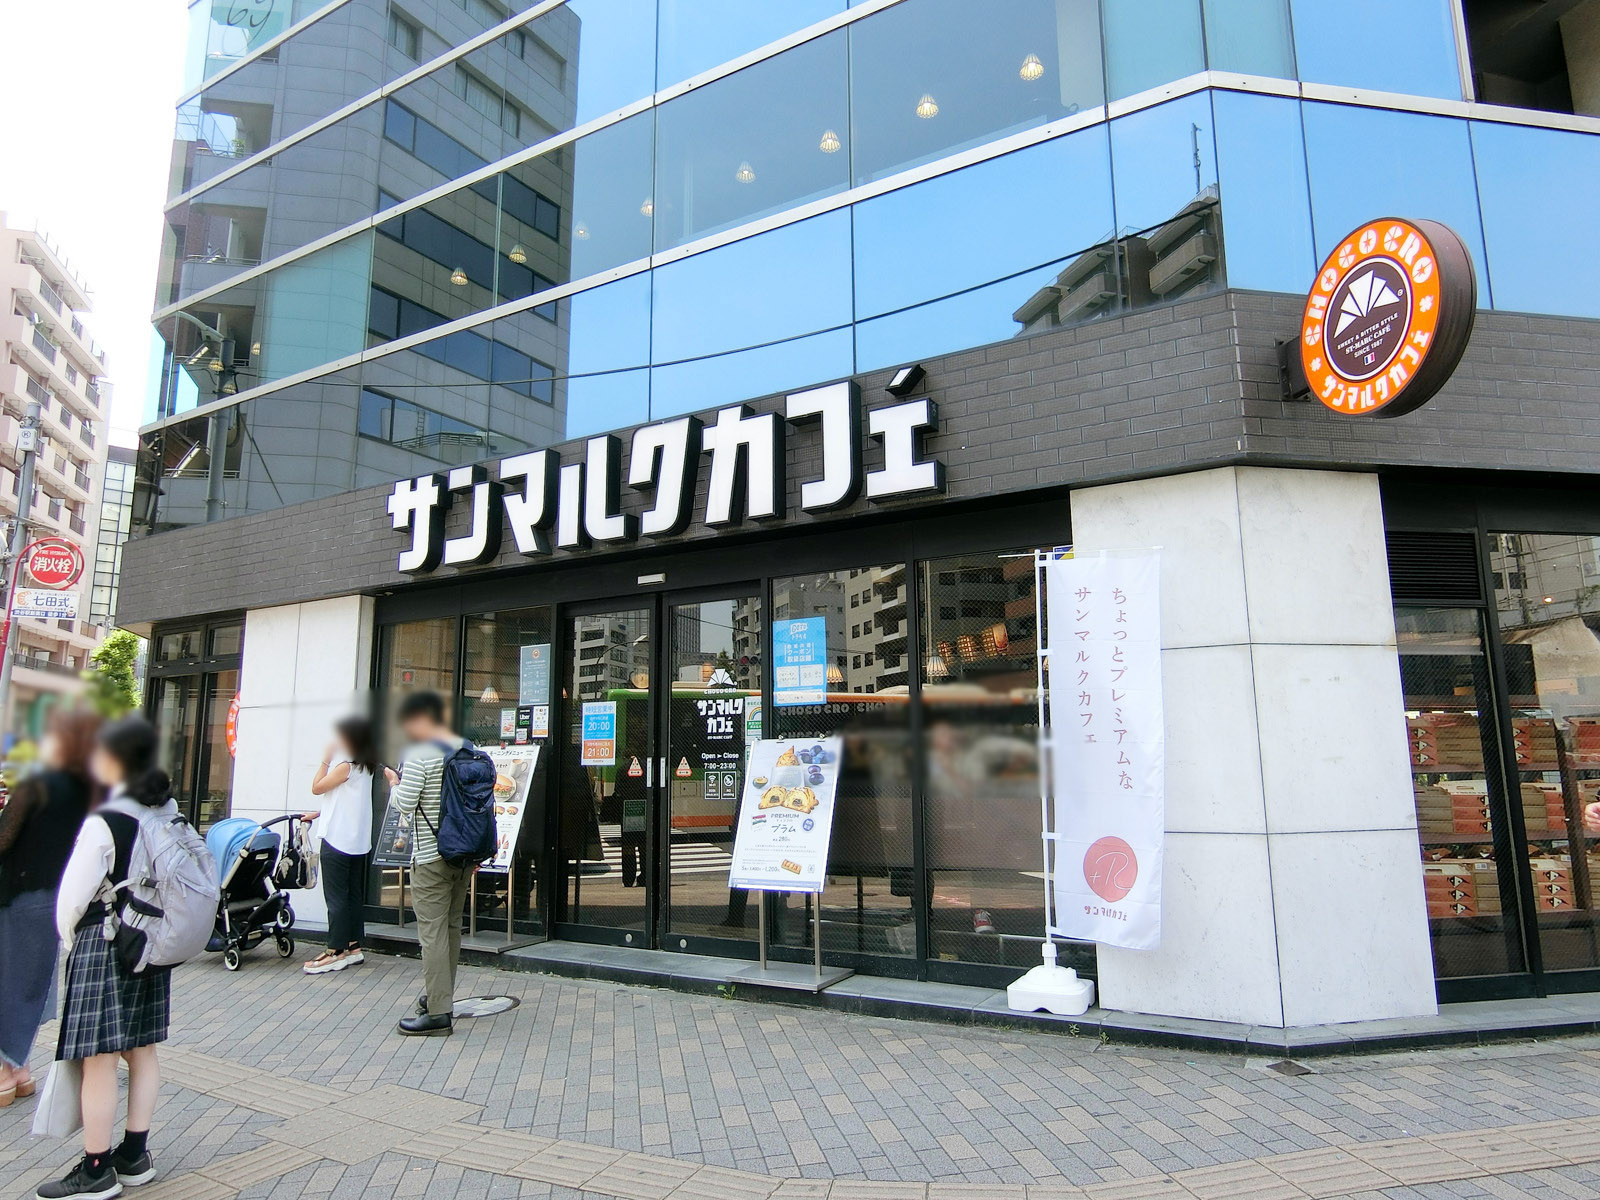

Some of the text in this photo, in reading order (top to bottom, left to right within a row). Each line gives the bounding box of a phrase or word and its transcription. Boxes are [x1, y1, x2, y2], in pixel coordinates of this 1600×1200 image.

[1321, 330, 1431, 410] サンマルクカフェ
[387, 364, 943, 574] サンマルクカフェ
[33, 556, 72, 574] 消火栓
[34, 595, 70, 608] 七田式
[1074, 587, 1097, 743] サンマルクカフェ
[1111, 587, 1134, 790] ちょっとプレミアムな
[697, 698, 744, 716] サンマルク
[588, 721, 610, 731] 20:00
[706, 716, 734, 733] カフェ
[587, 747, 610, 757] 21:00
[771, 823, 797, 833] プラム
